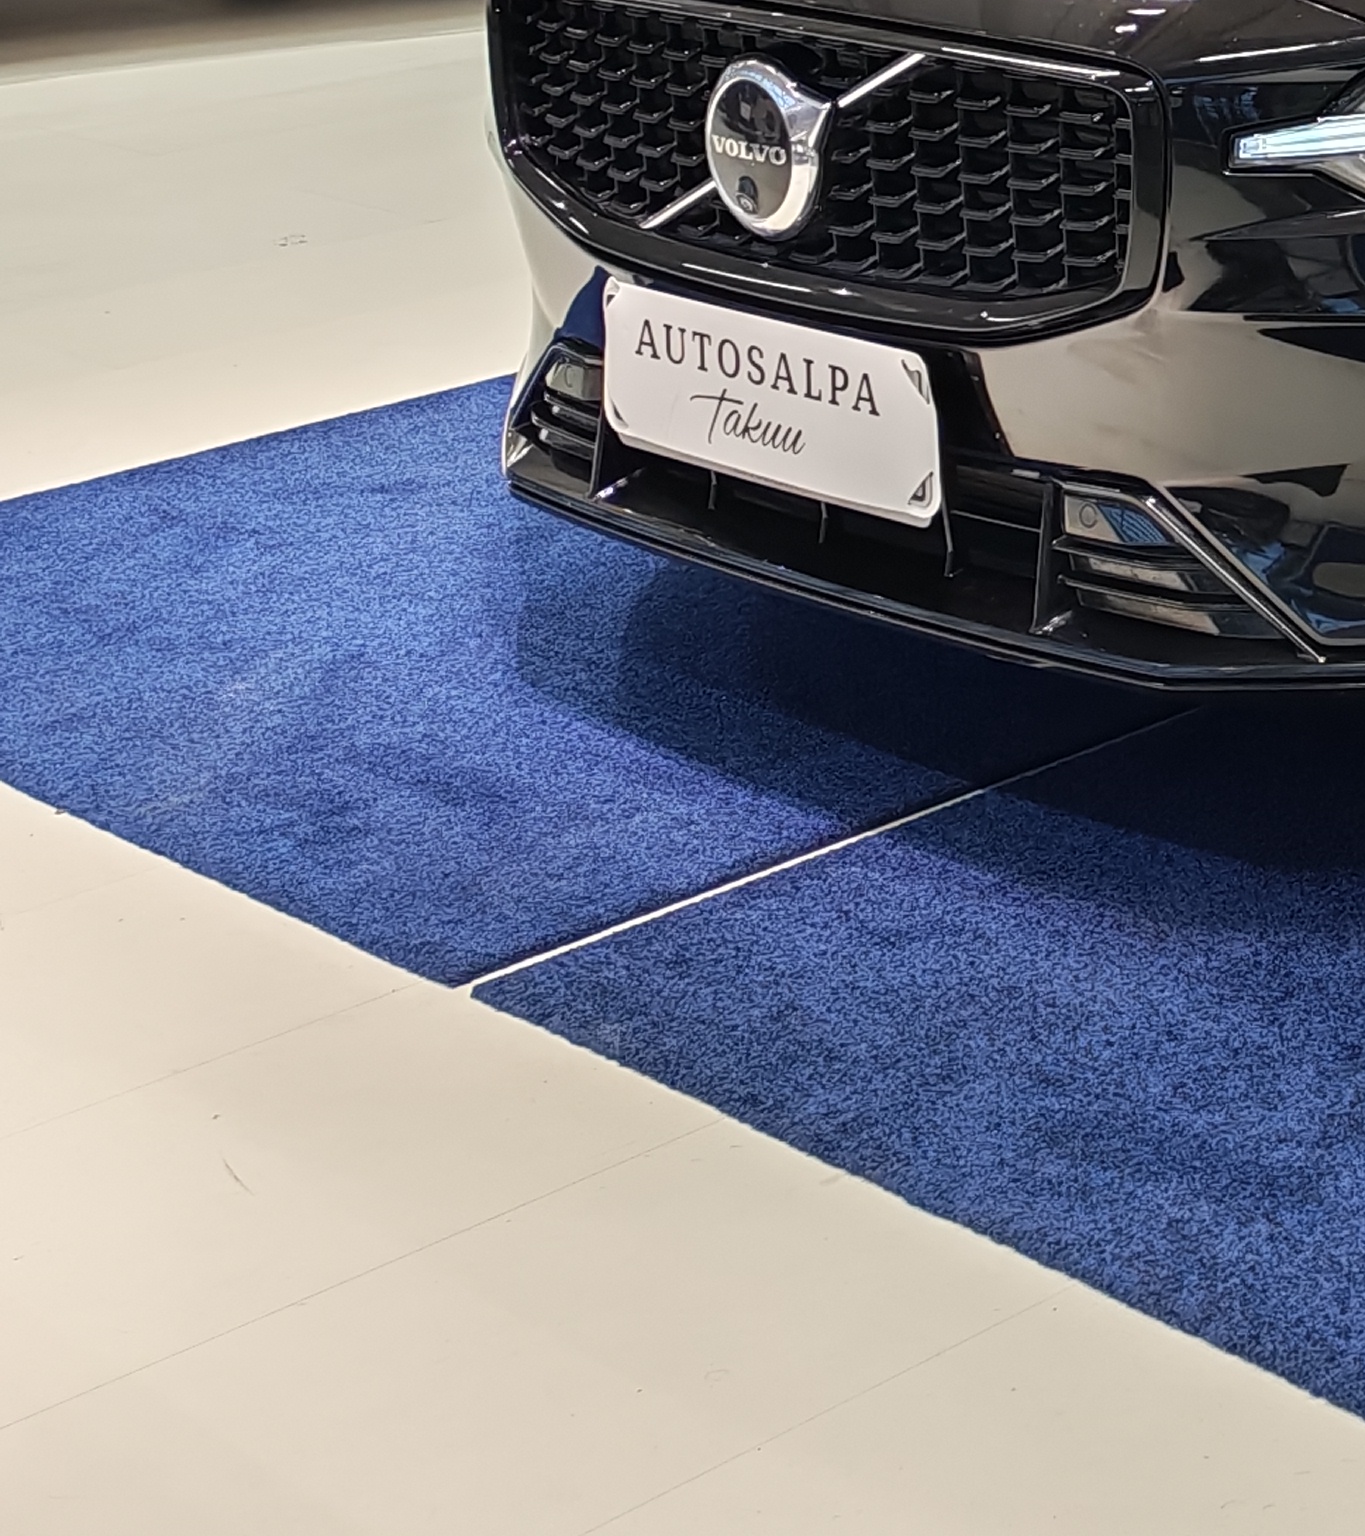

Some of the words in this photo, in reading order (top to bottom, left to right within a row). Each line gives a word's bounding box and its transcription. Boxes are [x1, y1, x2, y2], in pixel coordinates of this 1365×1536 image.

[712, 135, 787, 166] VOLVO
[635, 319, 880, 416] AUTOSALPA
[690, 388, 805, 455] Takuu
